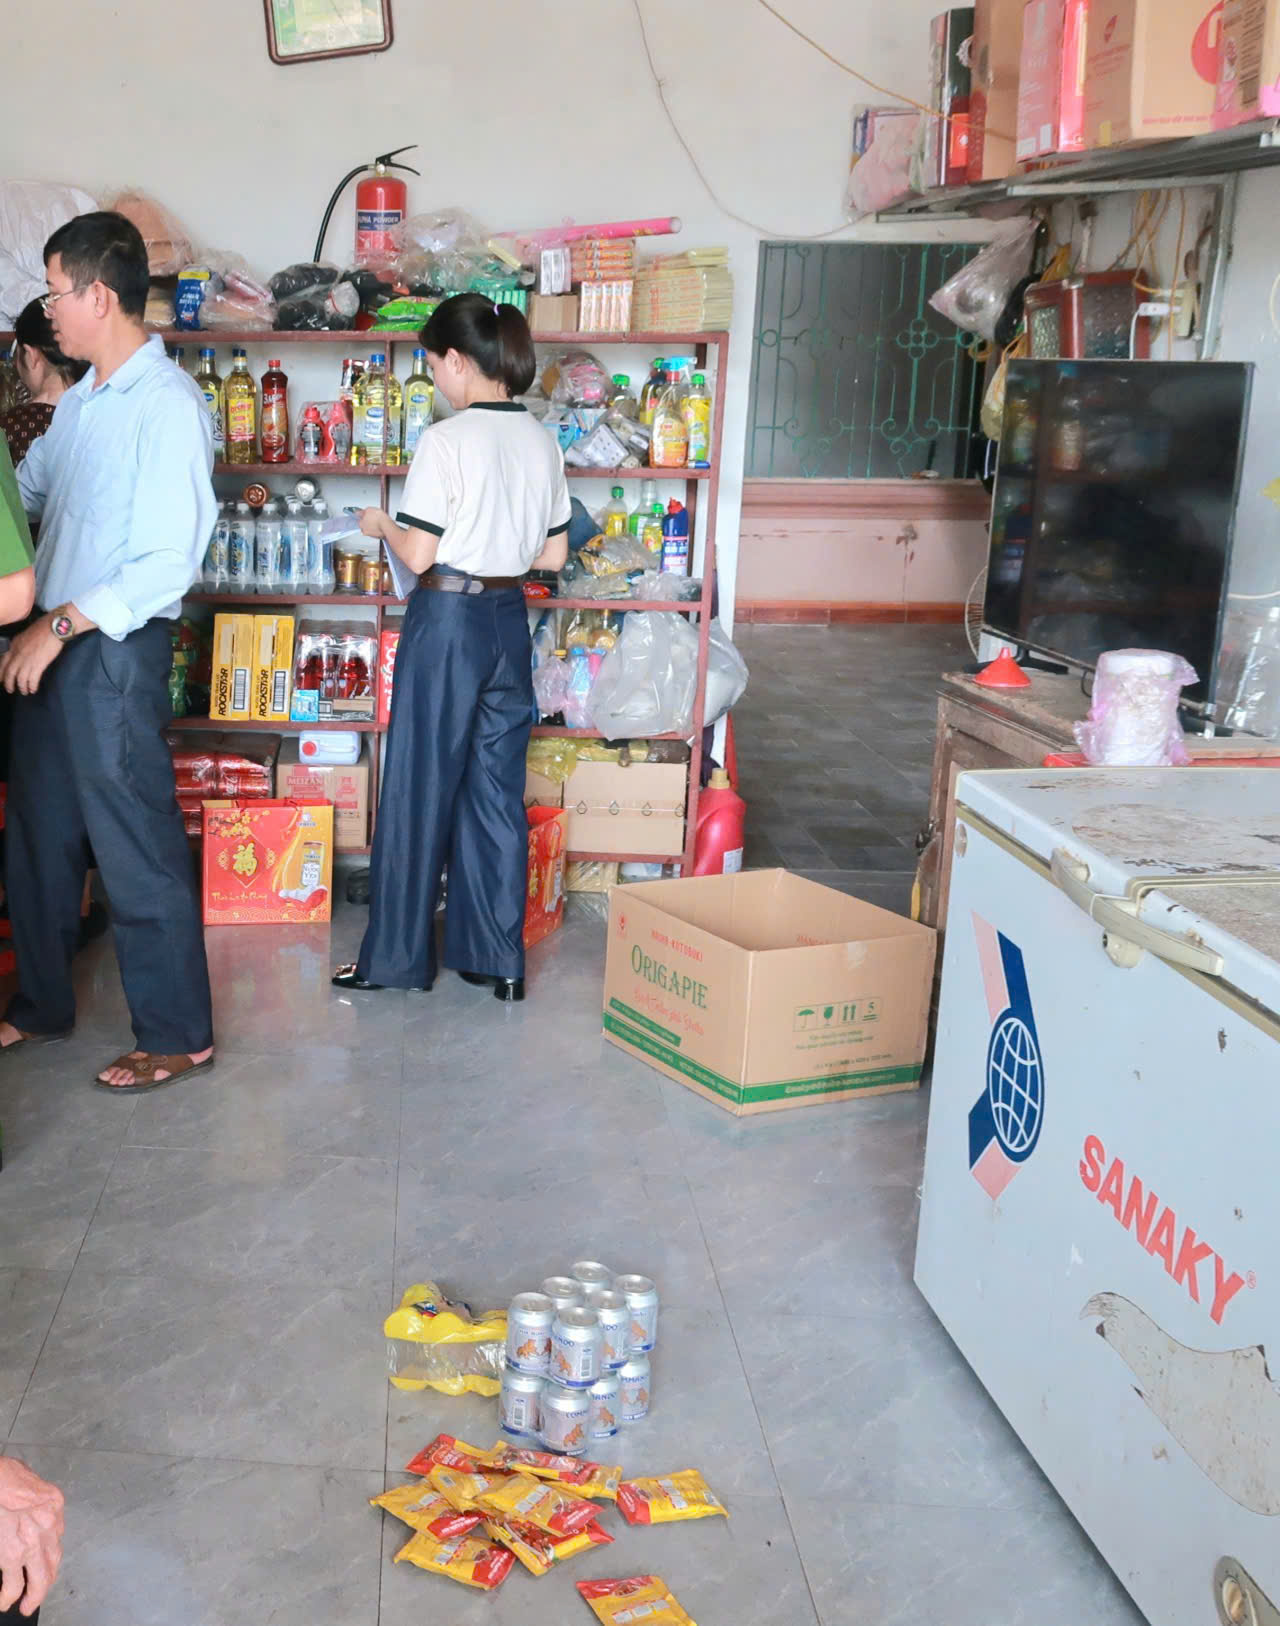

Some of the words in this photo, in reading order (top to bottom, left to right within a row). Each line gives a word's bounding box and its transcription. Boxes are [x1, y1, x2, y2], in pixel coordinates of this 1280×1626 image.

[218, 667, 229, 717] ROCKSTAR
[258, 669, 270, 718] ROCKSTAR
[631, 943, 709, 1010] ORIGAPIE
[1079, 1134, 1246, 1326] SANAKY
